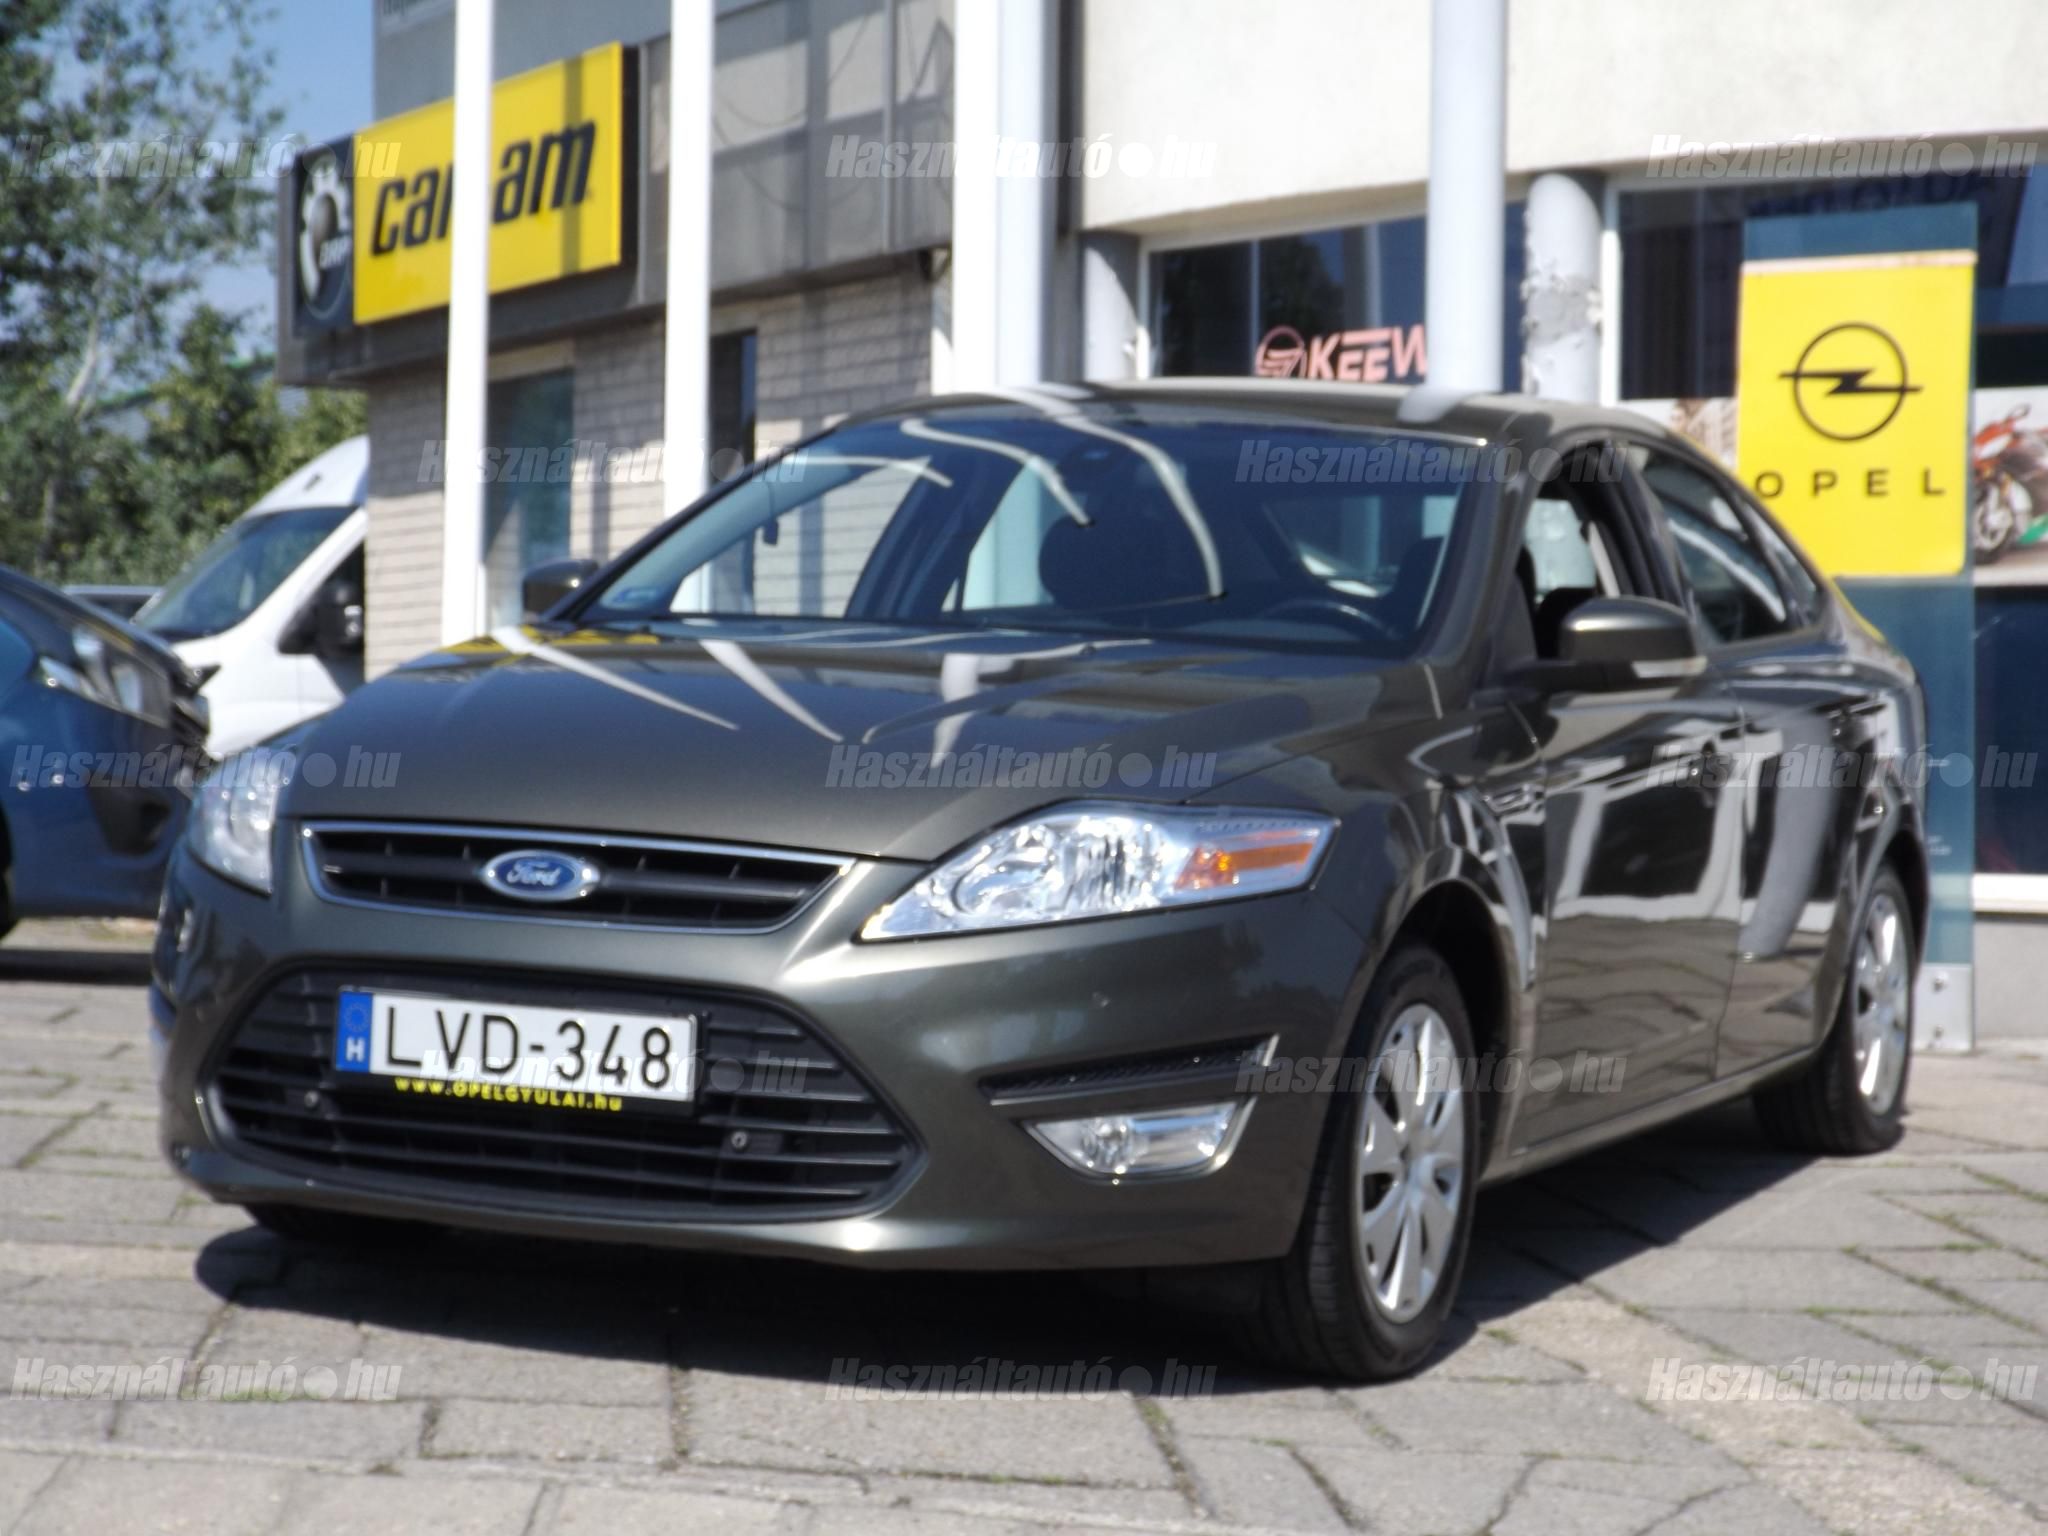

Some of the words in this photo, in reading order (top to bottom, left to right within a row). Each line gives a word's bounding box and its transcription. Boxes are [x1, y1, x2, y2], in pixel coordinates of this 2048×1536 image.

[370, 119, 596, 256] caam
[1308, 325, 1428, 382] KEEW
[1754, 467, 1946, 499] OPEL
[506, 860, 562, 887] Ford
[345, 1036, 366, 1063] H
[386, 1006, 671, 1090] LVD-348
